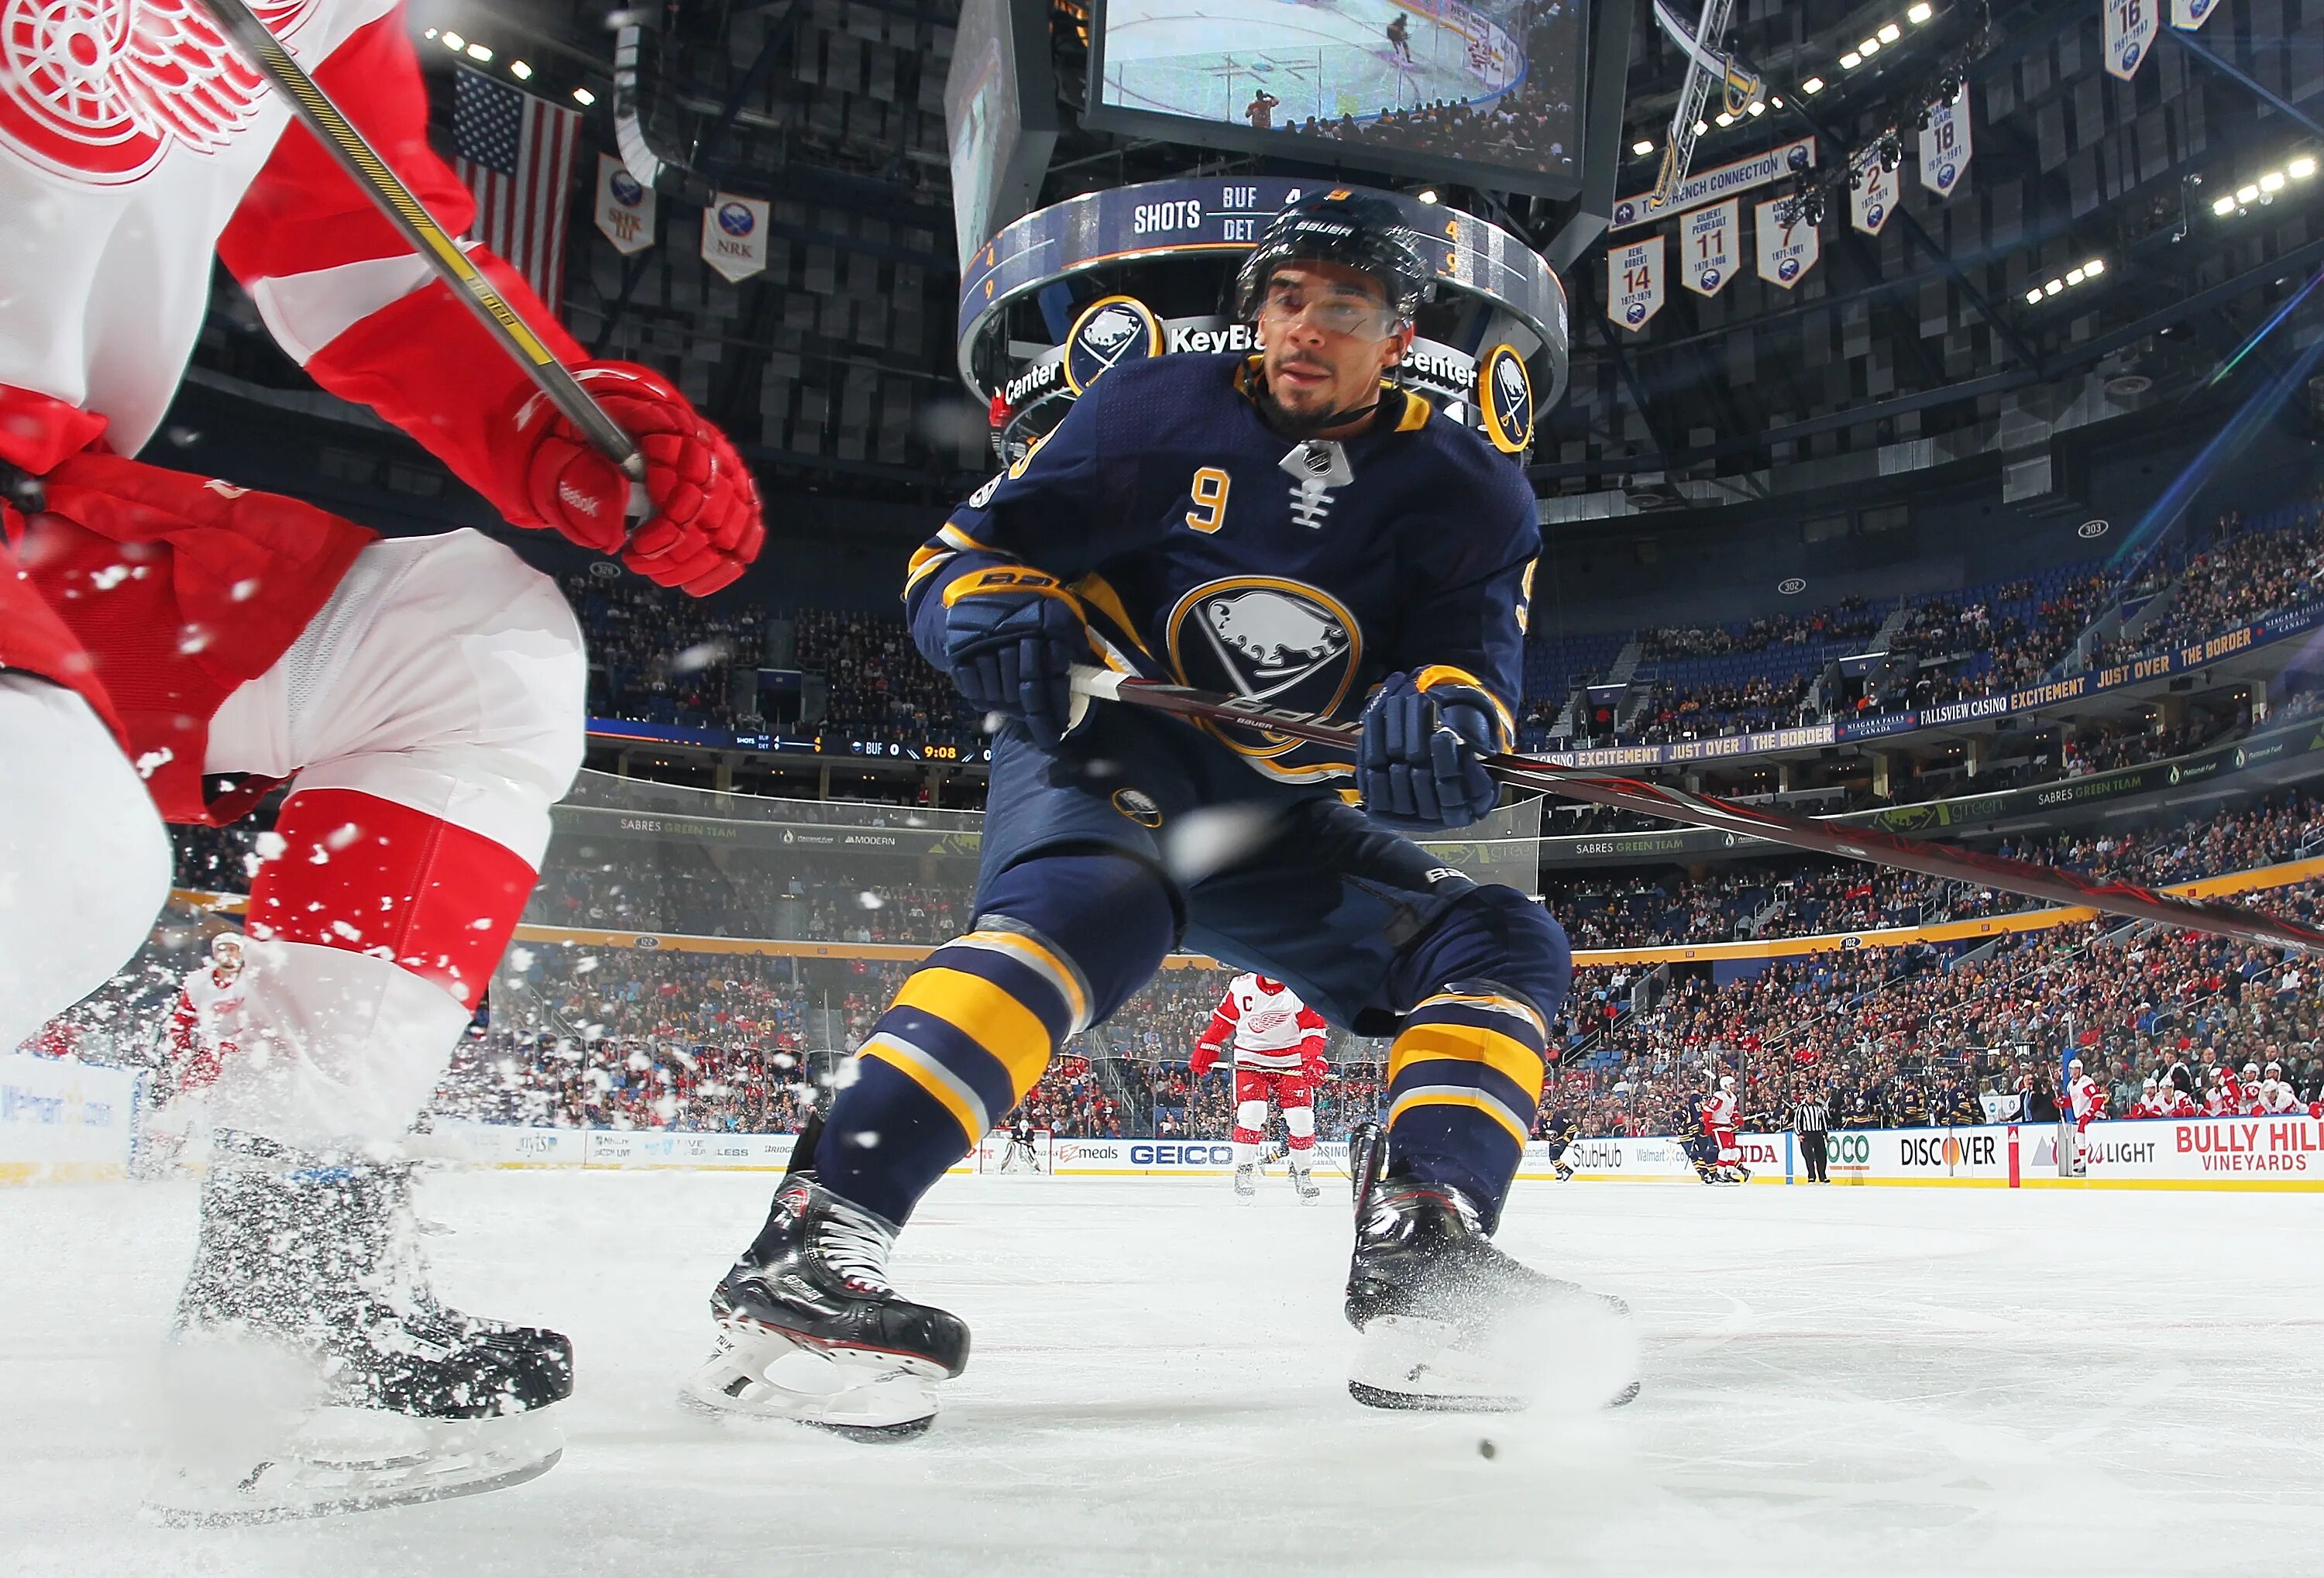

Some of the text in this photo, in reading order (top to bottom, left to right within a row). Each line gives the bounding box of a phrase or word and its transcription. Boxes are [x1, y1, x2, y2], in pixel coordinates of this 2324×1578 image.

[2119, 0, 2140, 34] 16
[1934, 121, 1954, 155] 18
[1710, 156, 1779, 191] CONNECTION
[1867, 165, 1882, 194] 2
[1222, 187, 1259, 208] BUF
[1134, 199, 1201, 234] SHOTS
[1697, 208, 1721, 223] GILBERT
[1223, 219, 1255, 240] DET
[1445, 220, 1458, 240] 4
[717, 239, 752, 258] NRK
[1628, 246, 1644, 258] RENE
[1697, 229, 1723, 259] 11
[986, 247, 995, 266] 4
[1624, 254, 1648, 270] ROBERT
[985, 280, 995, 298] 9
[1623, 265, 1651, 294] 14
[1005, 360, 1061, 405] Center
[1186, 466, 1231, 535] 9
[2085, 523, 2102, 535] 303
[1784, 581, 1800, 592] 302
[2278, 617, 2311, 633] CANADA
[1920, 627, 2251, 726] FALLSVIEW CASINO EXCITEMENT JUST OVER THE BORDER
[1236, 717, 1273, 730] BAUER
[1847, 714, 1905, 731] NIAGARA FALLS
[1860, 725, 1891, 736] CANADA
[814, 736, 821, 744] 4
[1578, 748, 1660, 766] EXCITEMENT
[1669, 743, 1701, 760] JUST
[1706, 738, 1740, 756] OVER
[1752, 734, 1776, 750] THE
[1780, 727, 1833, 748] BORDER
[865, 741, 992, 761] BUF 0 9:08 0
[1952, 777, 2142, 823] green SABRES GREEN TEAM
[621, 818, 737, 837] SABRES GREEN TEAM
[854, 836, 896, 846] MODERN
[1576, 843, 1614, 854] SABRES
[1616, 841, 1653, 852] GREEN
[1655, 838, 1683, 851] TEAM
[1845, 937, 1857, 947] 102
[1242, 995, 1253, 1012] C
[2175, 1122, 2261, 1153] BULLY
[1130, 1146, 1233, 1164] GEICO
[1573, 1142, 1622, 1168] StubHub
[1636, 1148, 1666, 1163] Walmart
[1741, 1145, 1778, 1163] NDA
[1901, 1136, 1996, 1166] DISCOVER
[2107, 1143, 2155, 1163] LIGHT
[2202, 1153, 2307, 1172] VINEYARDS
